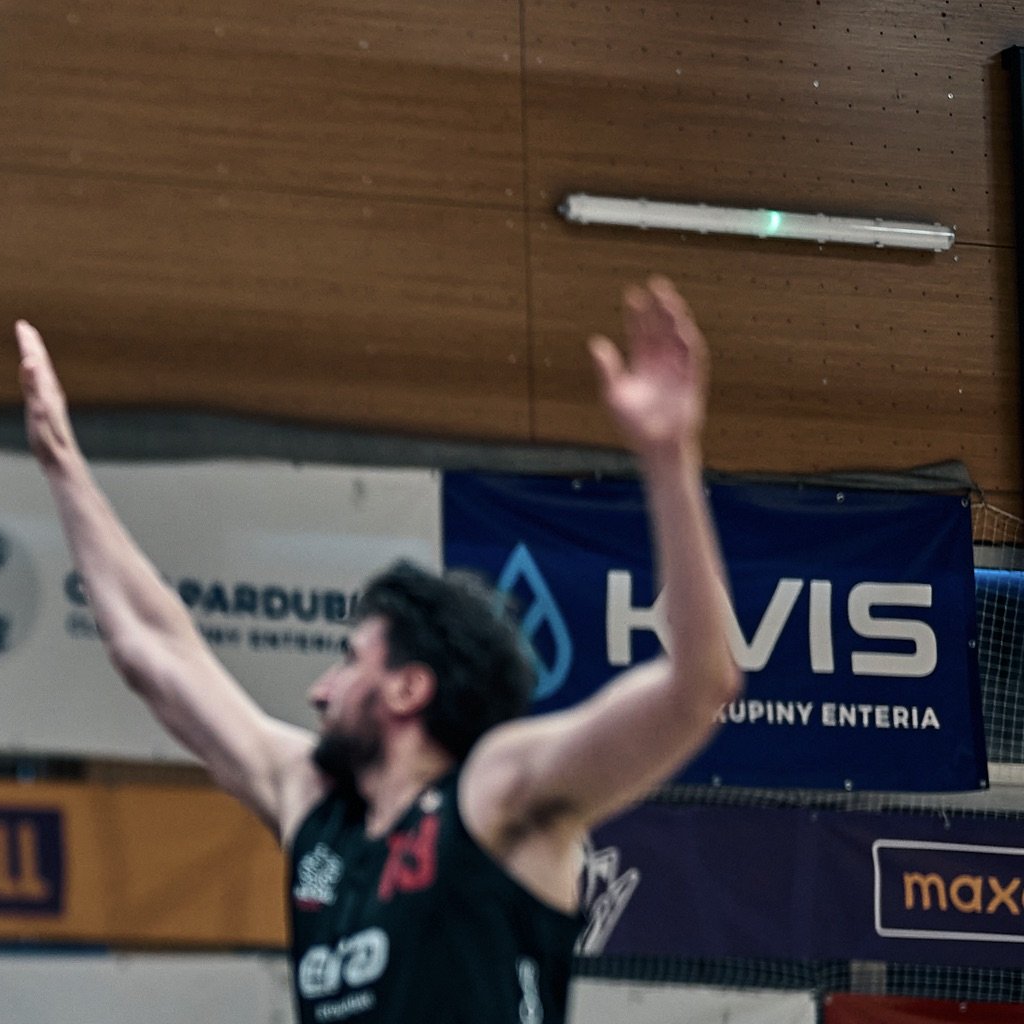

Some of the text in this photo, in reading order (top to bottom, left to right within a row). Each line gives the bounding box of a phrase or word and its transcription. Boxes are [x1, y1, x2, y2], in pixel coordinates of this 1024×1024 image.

[178, 577, 360, 622] PARDUB
[606, 570, 939, 678] KVIS
[711, 699, 941, 730] KUPINY ENTERIA
